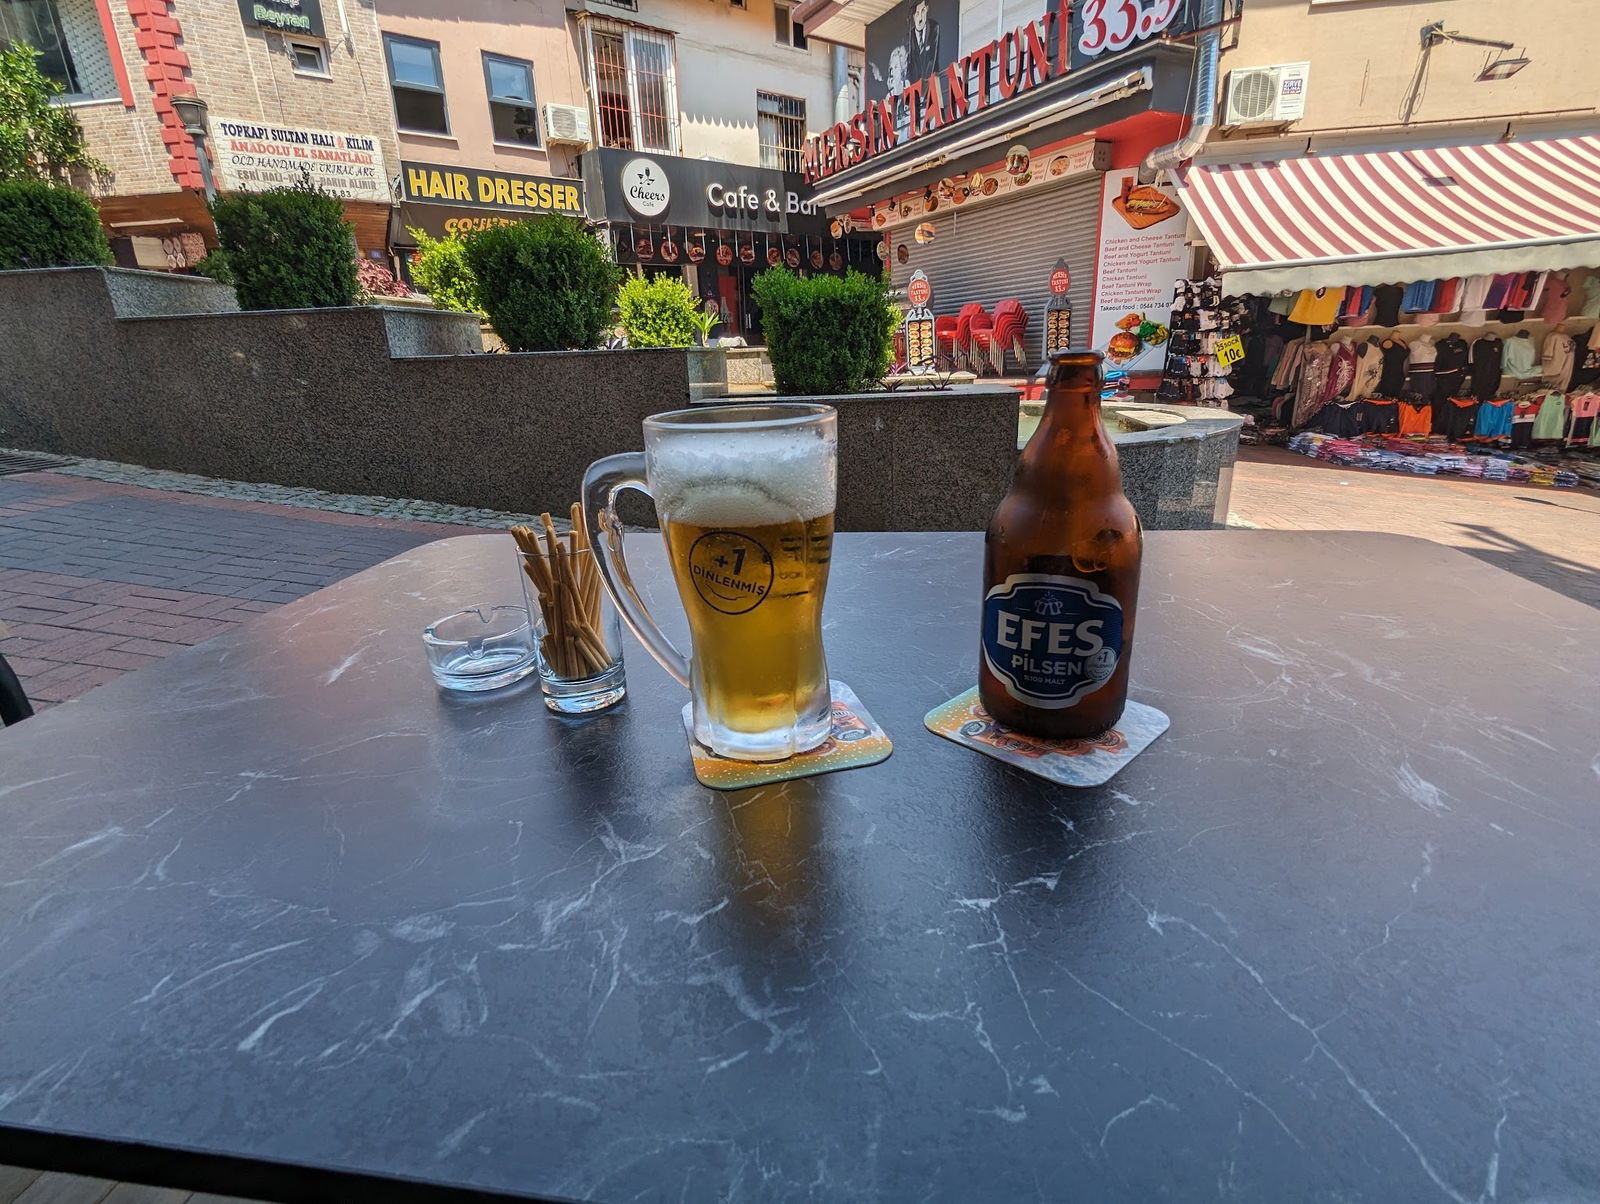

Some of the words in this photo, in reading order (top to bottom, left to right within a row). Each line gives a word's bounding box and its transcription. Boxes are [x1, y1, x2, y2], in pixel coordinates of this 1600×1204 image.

[221, 123, 269, 140] TOPKAPI
[271, 129, 309, 144] SULTAN
[311, 133, 335, 147] HALI
[345, 134, 374, 151] KİLİM
[230, 140, 290, 156] ANADOLU
[293, 146, 308, 158] EL
[311, 149, 373, 165] SANATLARI
[232, 155, 254, 165] OLD
[320, 163, 354, 175] TRIBAL
[356, 168, 375, 177] ART
[407, 168, 473, 201] HAIR
[477, 175, 581, 211] DRESSER
[630, 185, 666, 202] Cheers
[706, 182, 759, 210] Cafe
[766, 189, 780, 212] &
[786, 191, 820, 216] Bar
[1130, 250, 1149, 258] Yogurt
[1140, 257, 1158, 265] Yogurt
[1113, 297, 1133, 305] Burger
[693, 564, 765, 597] DİNLENMİŞ
[996, 610, 1104, 657] EFES
[1011, 653, 1082, 676] PİLSEN
